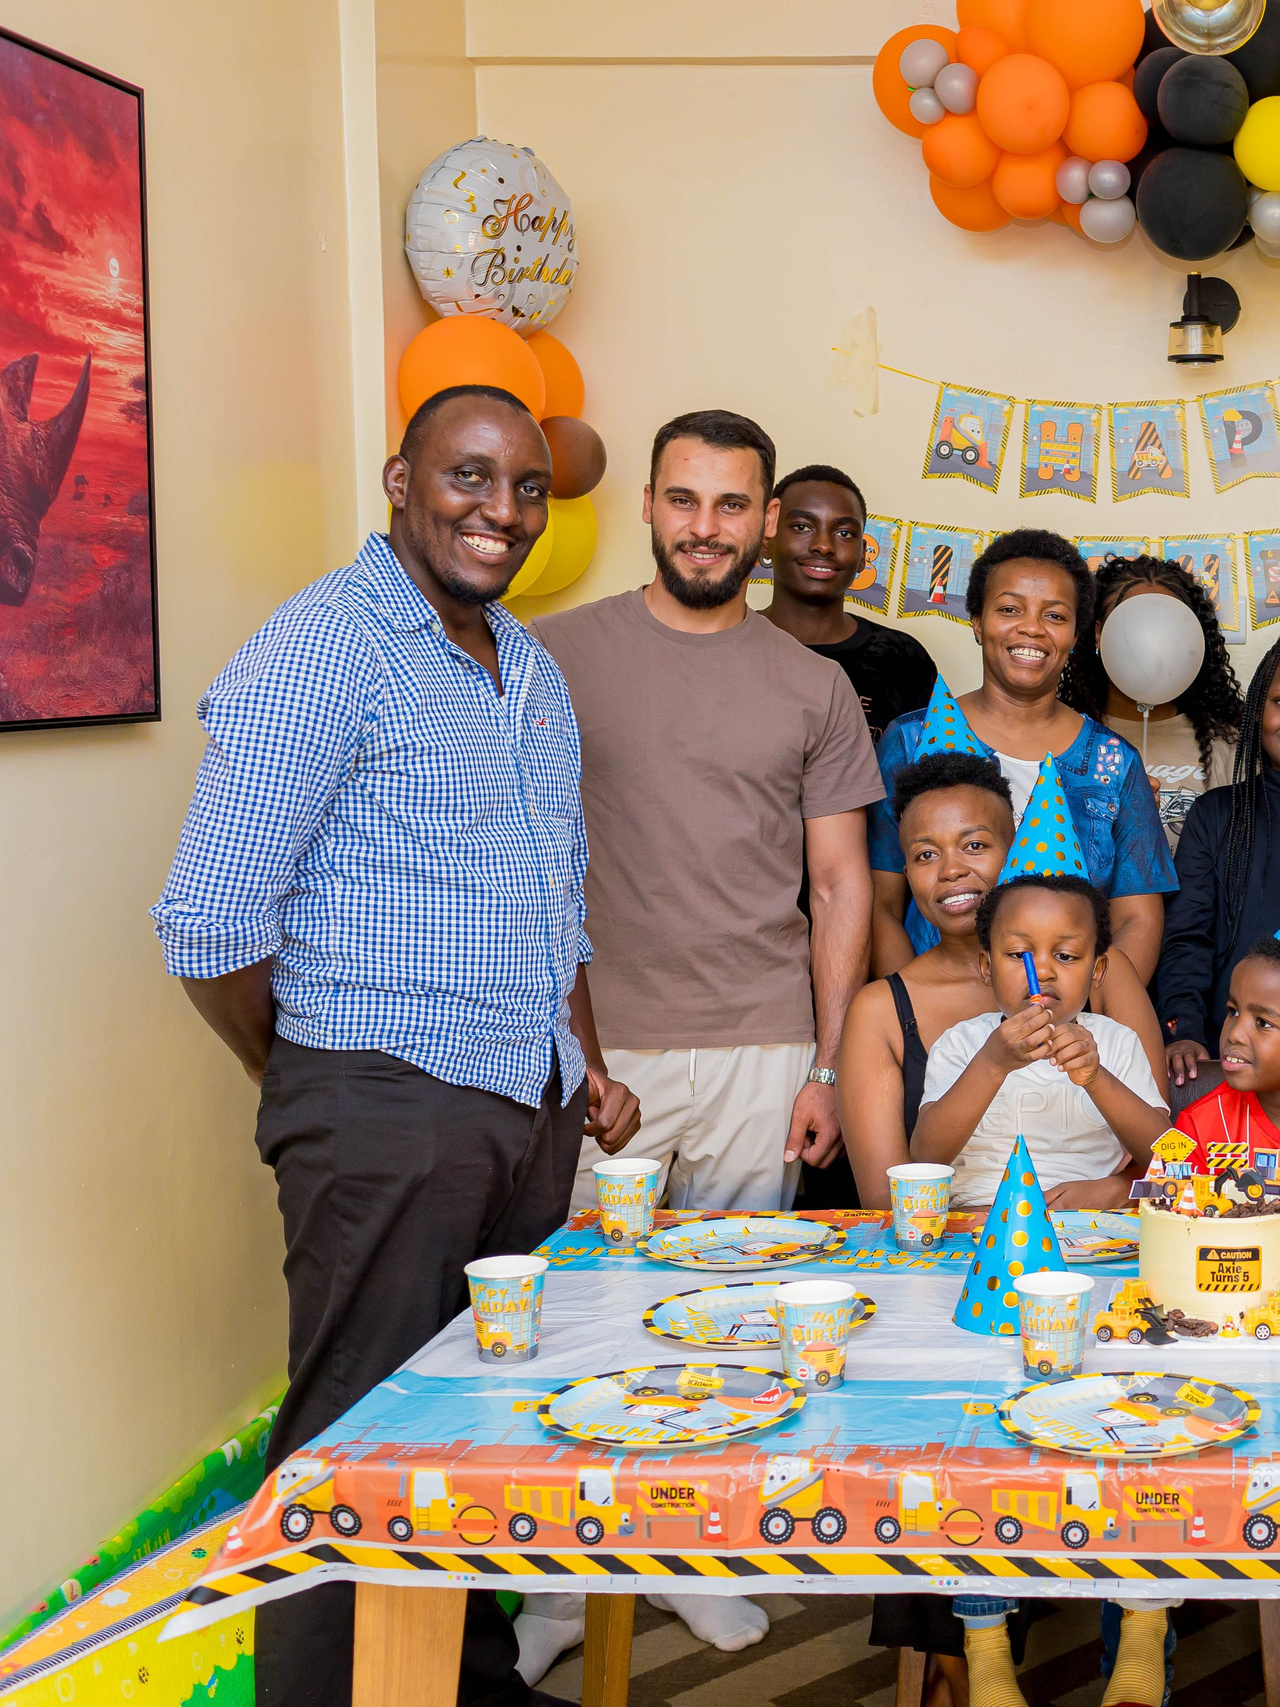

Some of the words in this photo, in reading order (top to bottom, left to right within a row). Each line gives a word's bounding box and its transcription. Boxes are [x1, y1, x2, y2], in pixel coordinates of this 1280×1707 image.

[481, 193, 577, 253] Happy
[470, 246, 573, 287] Birthda
[1161, 1142, 1176, 1151] DIG
[1178, 1141, 1187, 1150] IN
[919, 1182, 951, 1197] HAPP
[903, 1197, 950, 1210] BIRTH
[1220, 1251, 1252, 1259] CAUTION
[1217, 1261, 1242, 1274] Axie
[1210, 1271, 1240, 1283] Turns
[1243, 1271, 1250, 1282] 5
[471, 1284, 509, 1300] APPY
[1020, 1300, 1056, 1317] APPY
[811, 1307, 854, 1327] HAPP
[1020, 1315, 1075, 1331] THDAY
[791, 1326, 849, 1342] BIRTH
[650, 1487, 695, 1500] UNDER
[1135, 1492, 1180, 1505] UNDER
